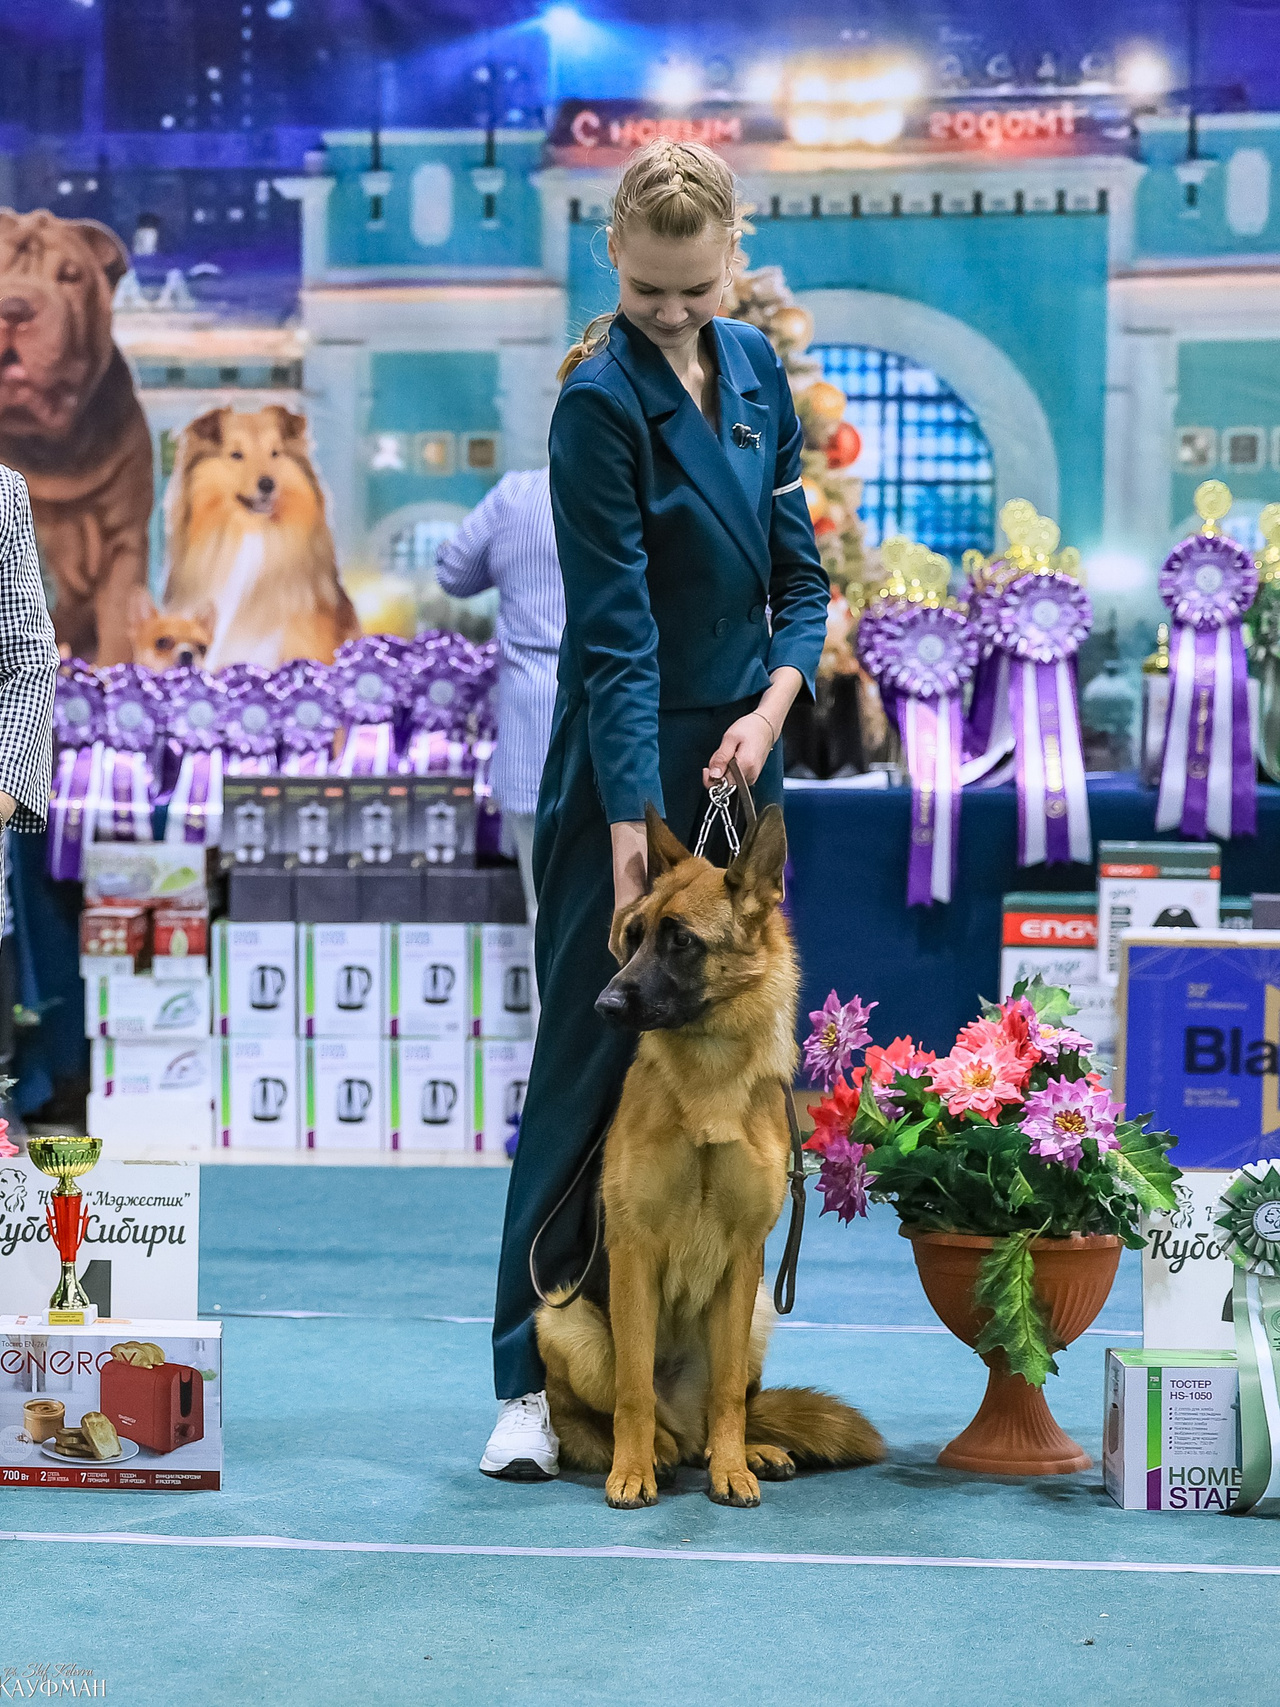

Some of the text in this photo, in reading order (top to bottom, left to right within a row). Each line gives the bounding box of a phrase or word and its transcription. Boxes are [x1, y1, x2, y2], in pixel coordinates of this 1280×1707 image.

[83, 1214, 187, 1258] Сибири
[1147, 1229, 1223, 1274] Кубо
[1170, 1380, 1212, 1389] ТОСТЕР
[1170, 1392, 1213, 1400] HS-1050
[2, 1470, 30, 1481] 700 Вт
[40, 1471, 47, 1482] 2
[80, 1472, 87, 1483] 7
